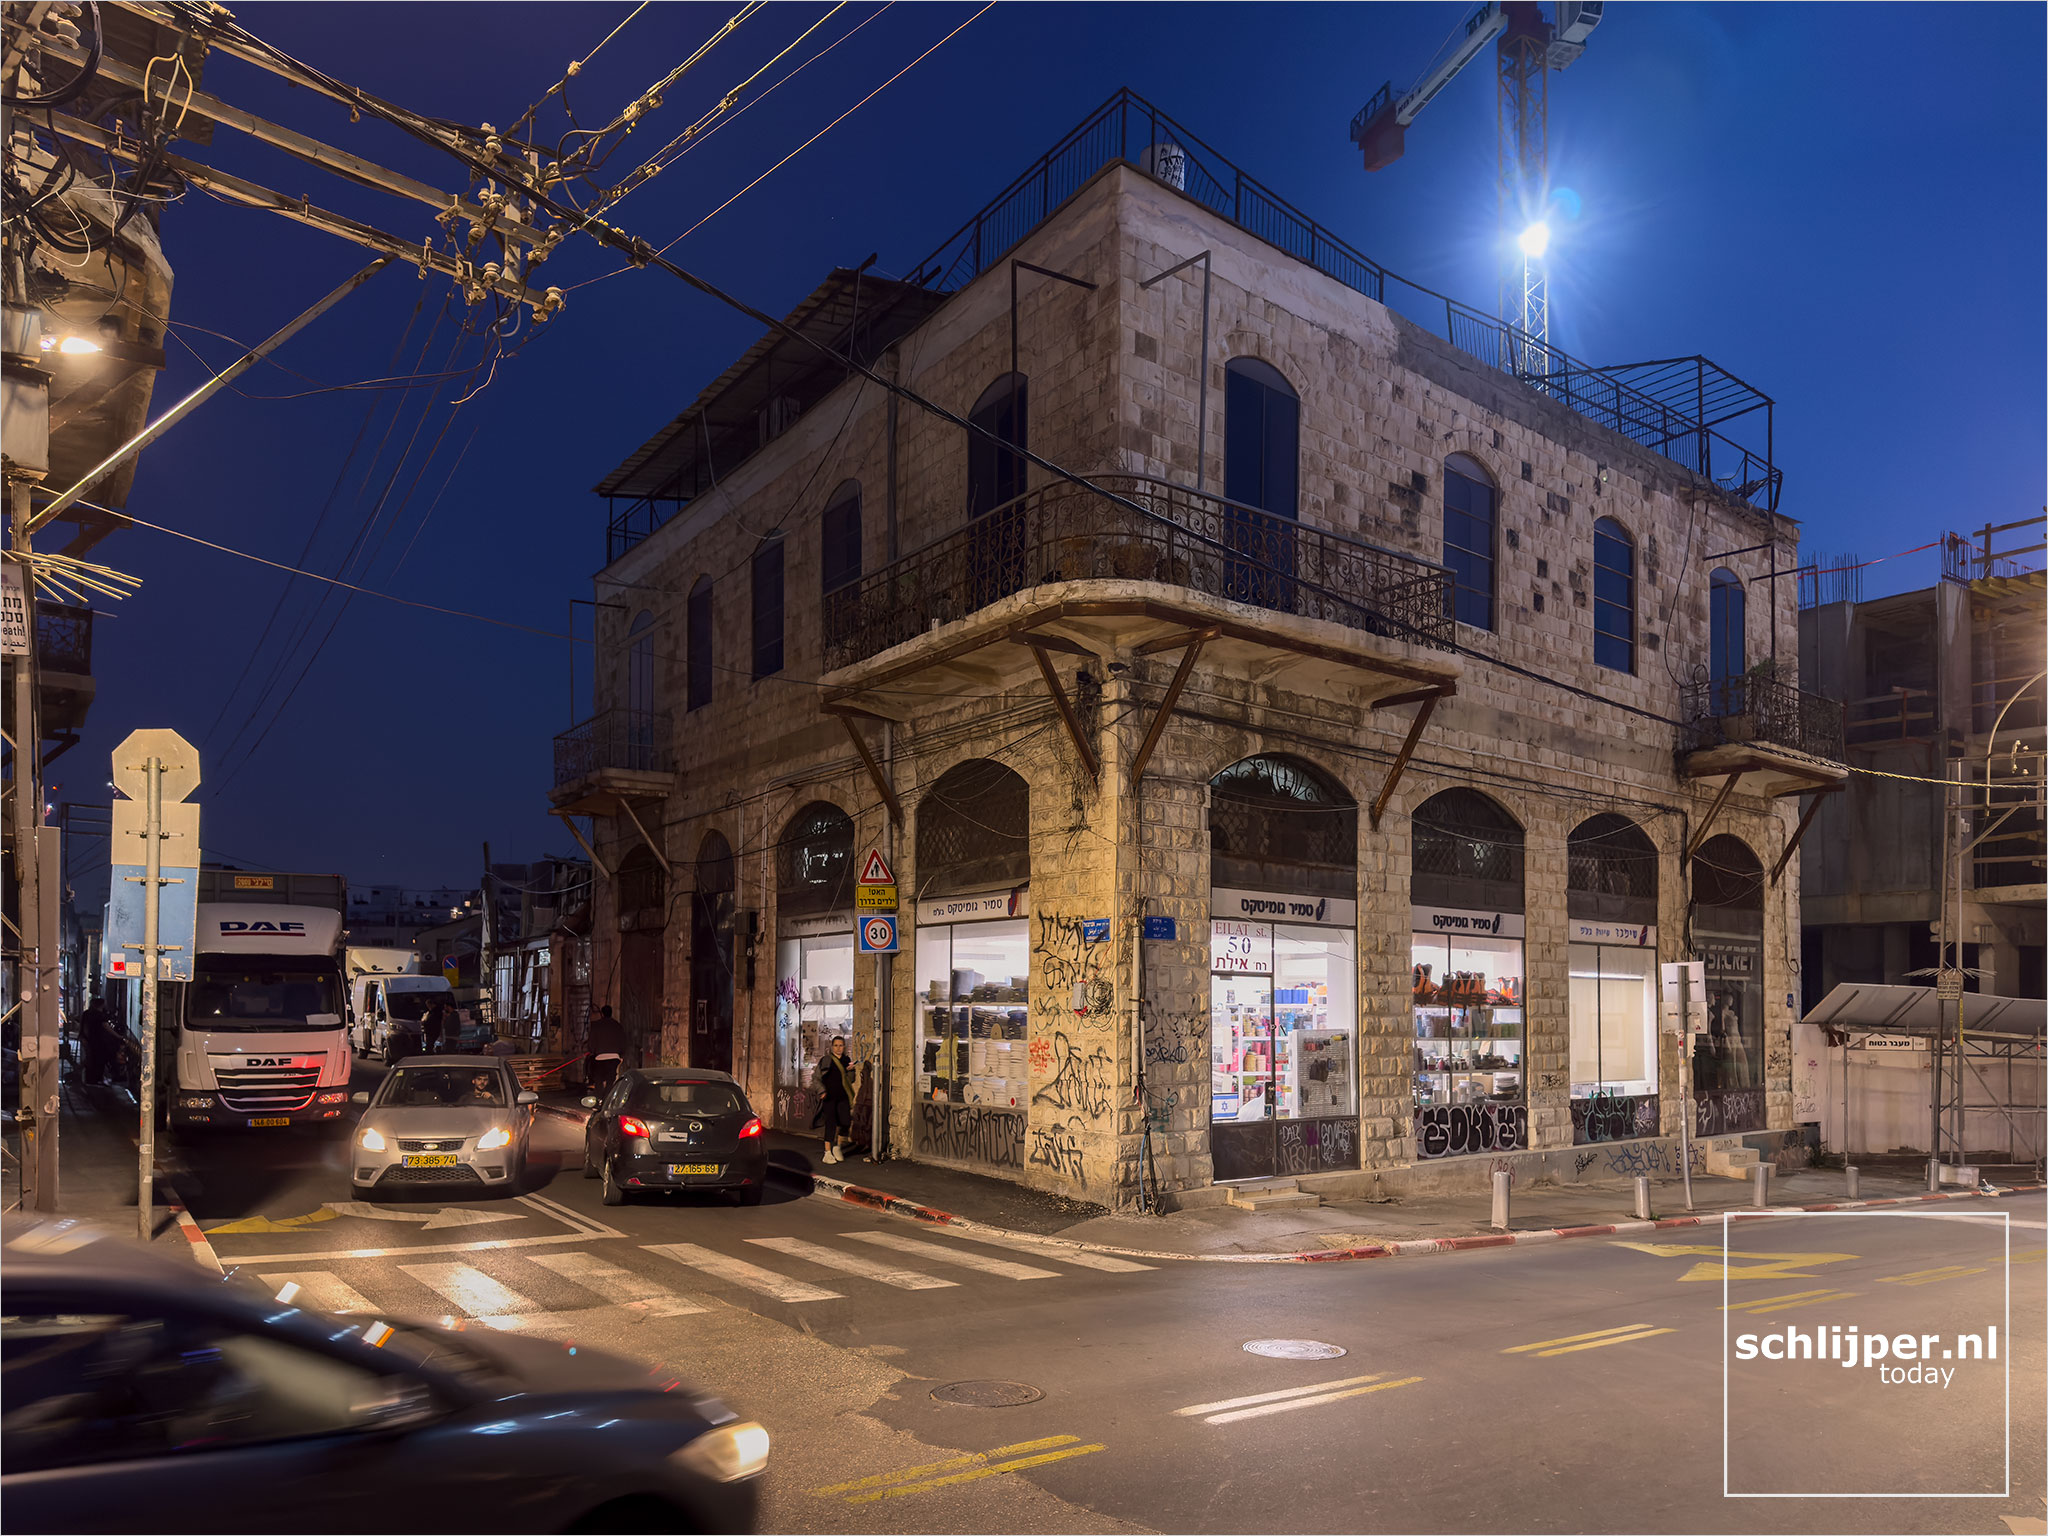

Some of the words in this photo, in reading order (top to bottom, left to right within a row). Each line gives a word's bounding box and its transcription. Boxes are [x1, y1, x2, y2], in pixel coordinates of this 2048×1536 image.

[1, 625, 25, 637] eath!
[859, 898, 876, 906] בדרך
[877, 897, 895, 905] ילדים
[219, 921, 305, 932] DAF
[1215, 922, 1250, 936] EILAT
[870, 927, 887, 940] 30
[1227, 936, 1252, 954] 50
[1215, 953, 1249, 970] אילת
[1889, 1040, 1910, 1048] מעבר
[246, 1058, 292, 1067] DAF
